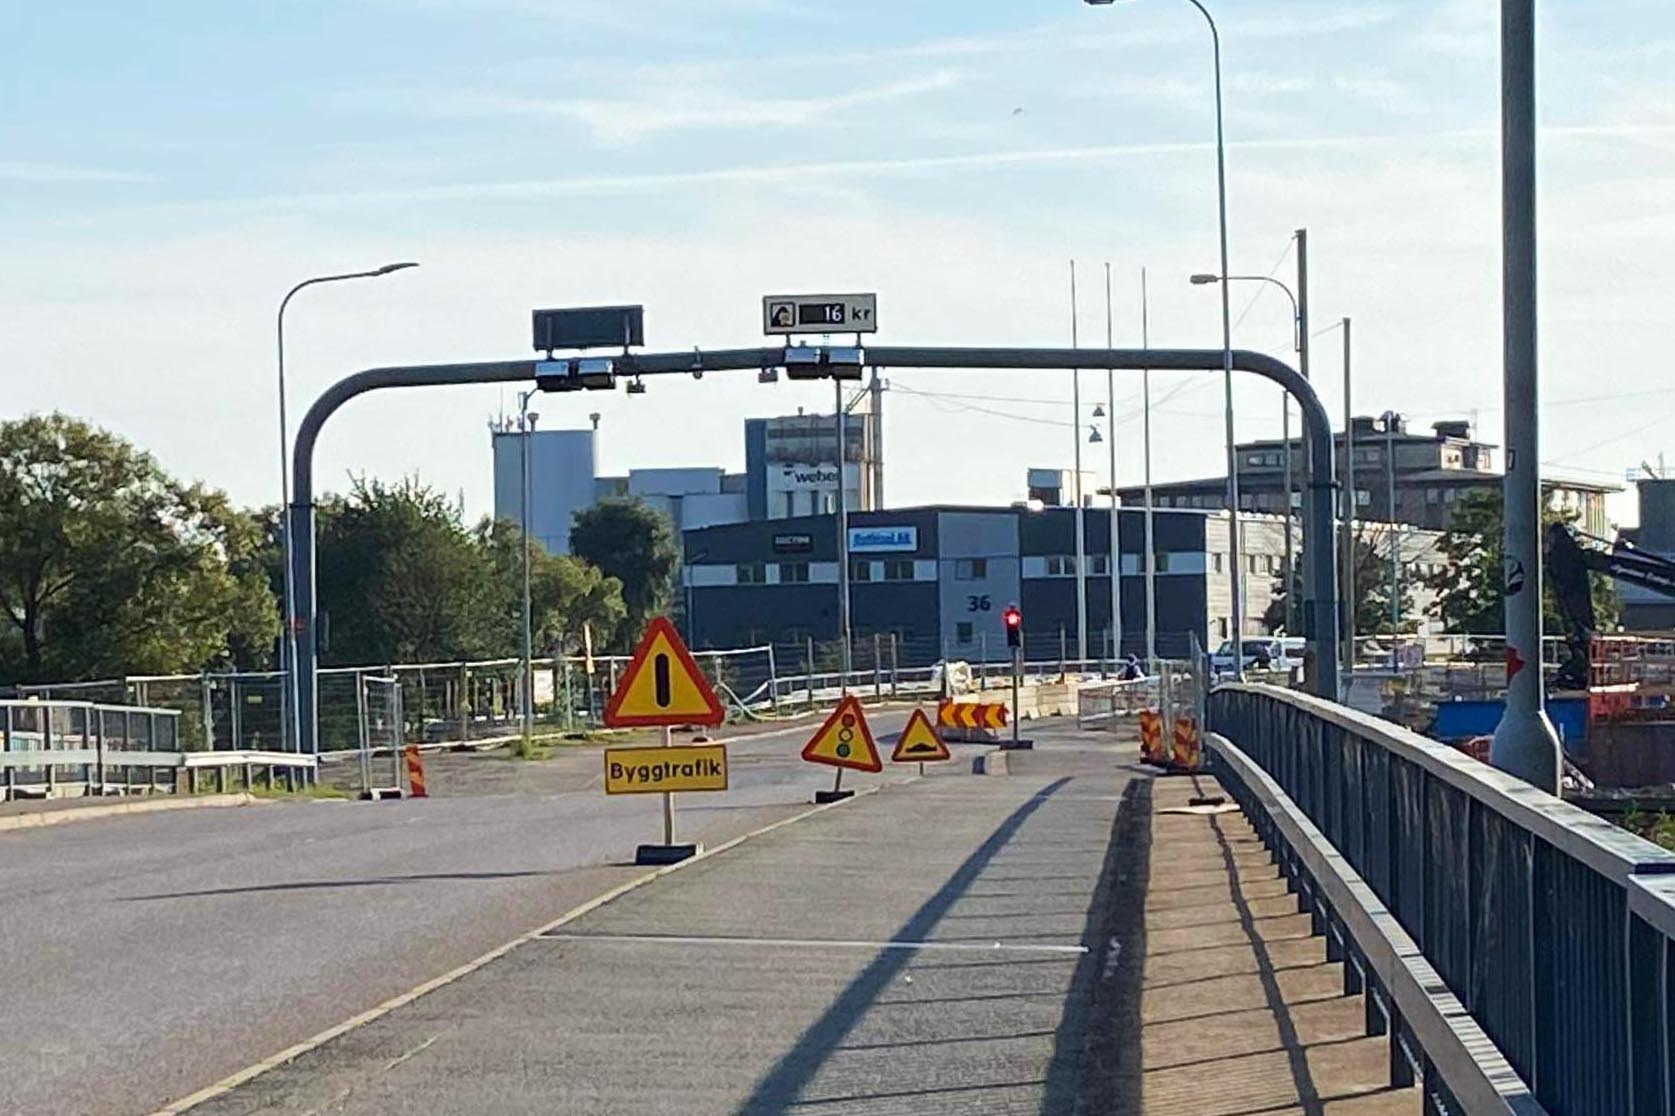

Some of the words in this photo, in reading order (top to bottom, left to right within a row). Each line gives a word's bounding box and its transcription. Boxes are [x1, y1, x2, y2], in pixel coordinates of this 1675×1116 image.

[824, 305, 842, 321] 16
[852, 306, 871, 321] kr
[967, 594, 991, 612] 36
[610, 758, 722, 784] Byggtrafik
